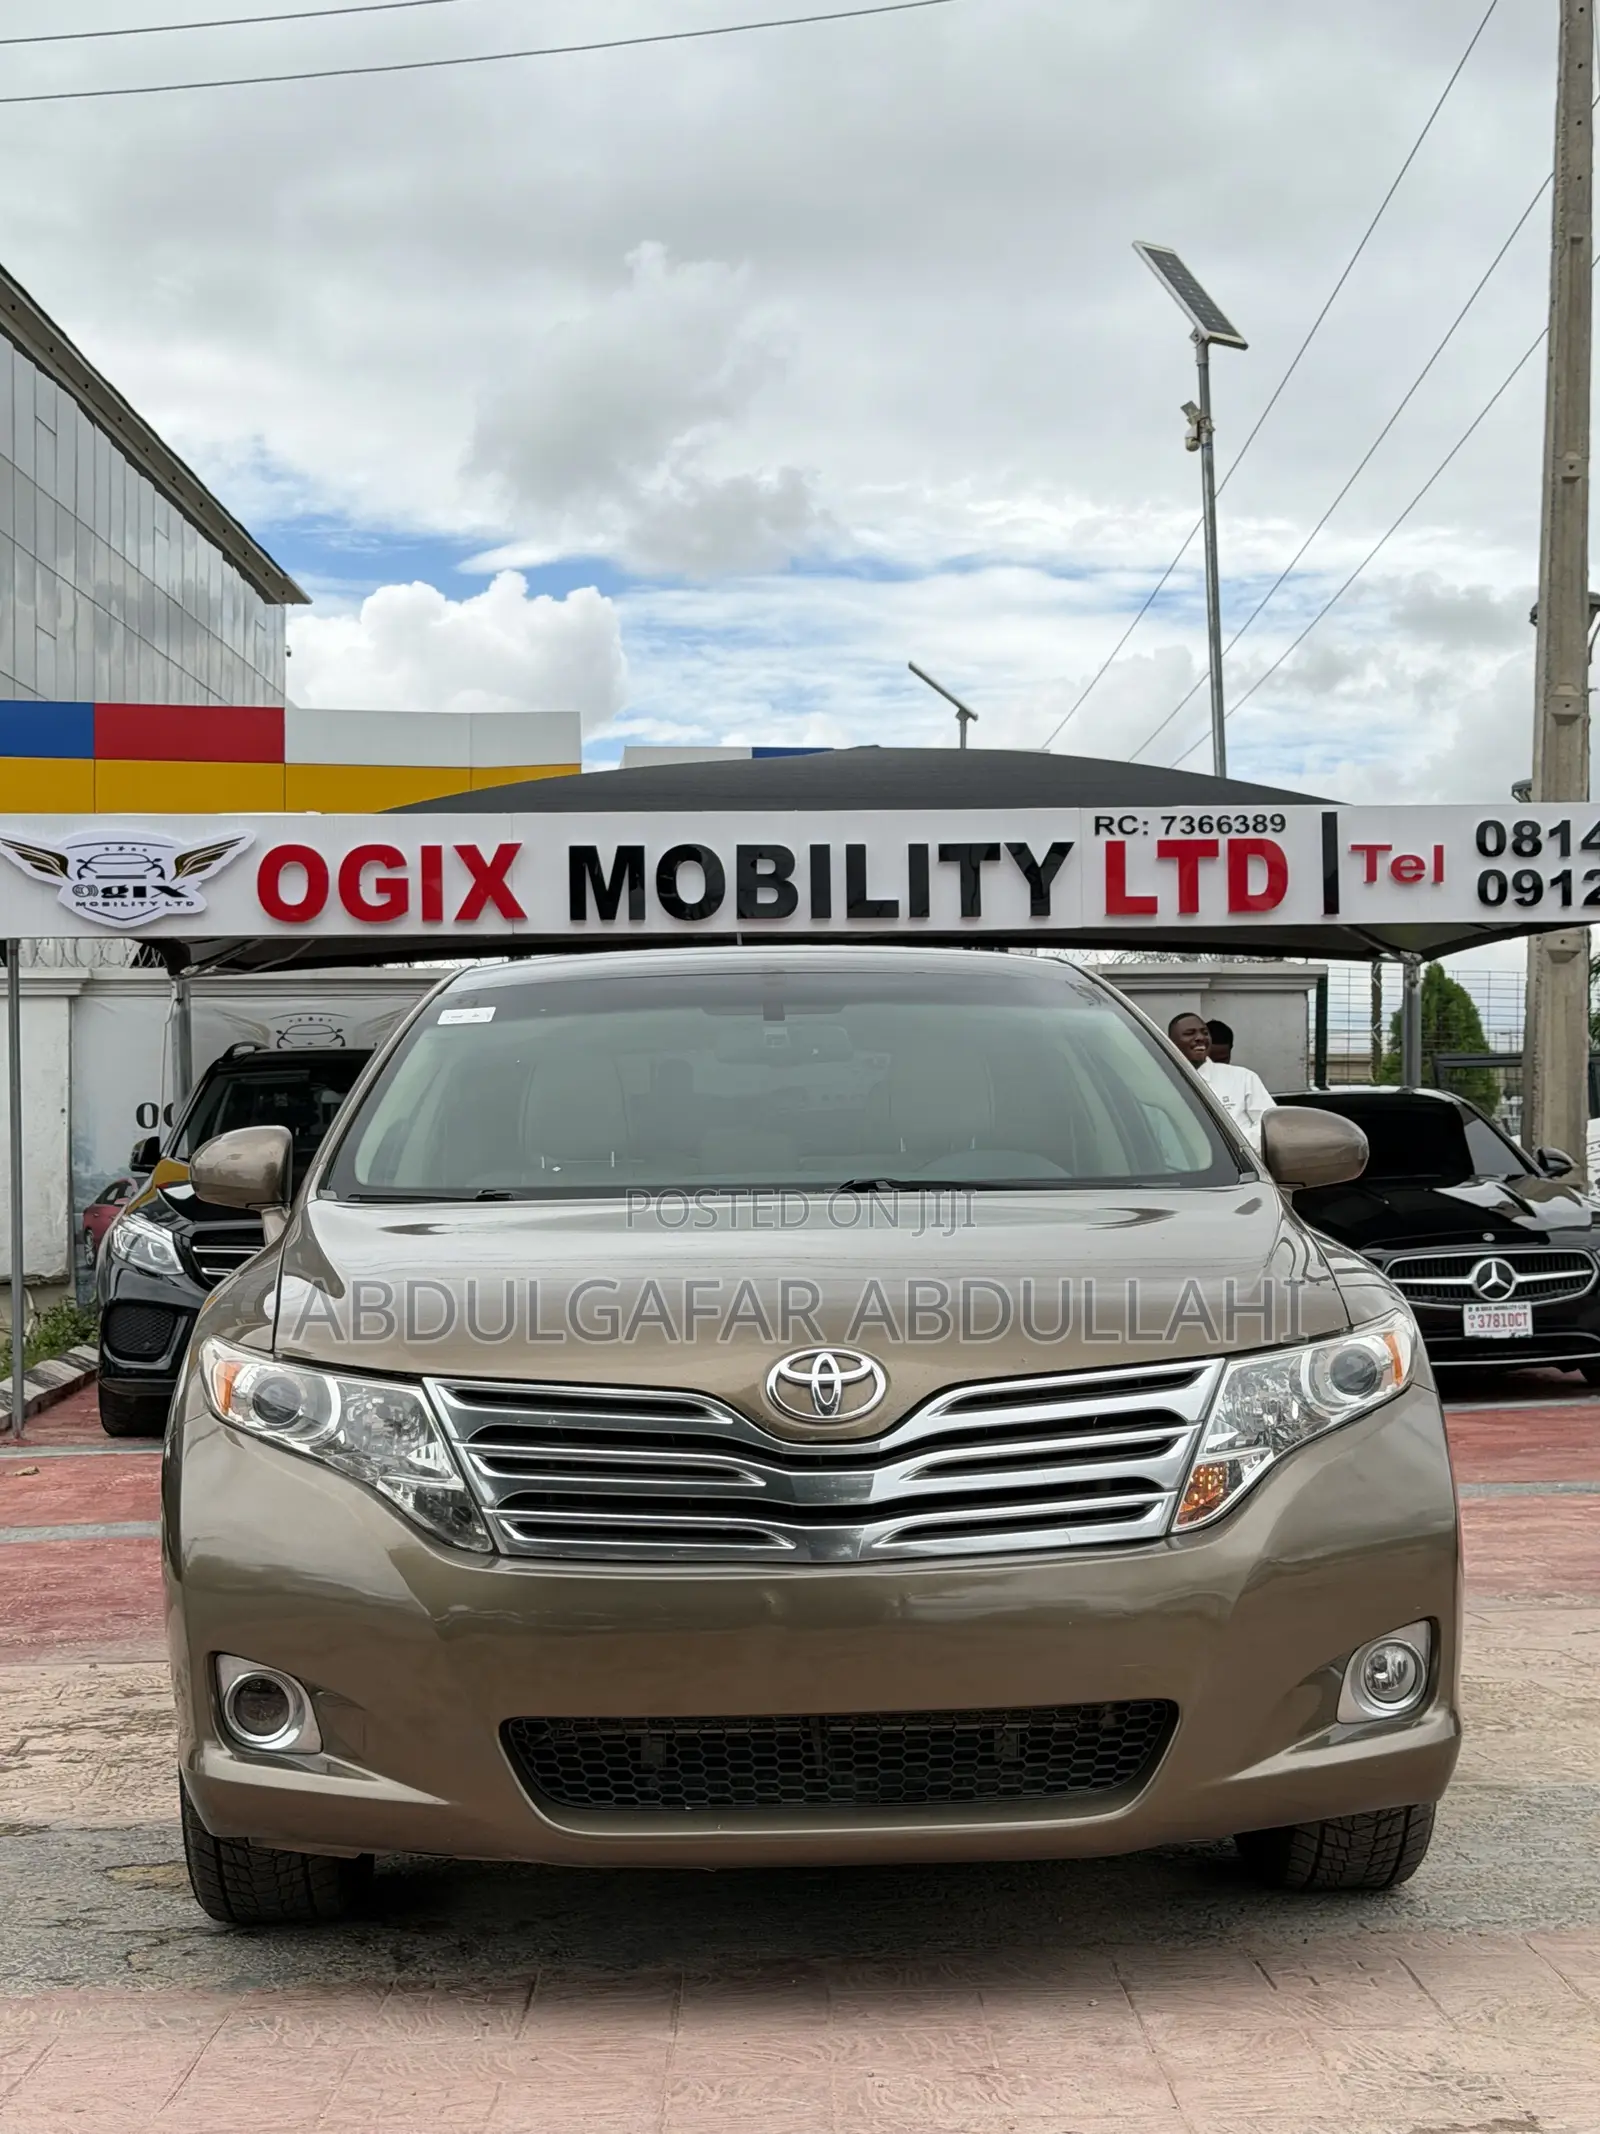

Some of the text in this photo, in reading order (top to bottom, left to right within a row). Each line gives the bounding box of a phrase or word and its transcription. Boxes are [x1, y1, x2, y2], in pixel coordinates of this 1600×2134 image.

[1094, 813, 1287, 836] RC: 7366389
[1476, 819, 1600, 858] 0814
[257, 838, 1289, 923] OGIX MOBILITY LTD
[1349, 844, 1445, 883] Tel
[1477, 868, 1600, 907] 0912
